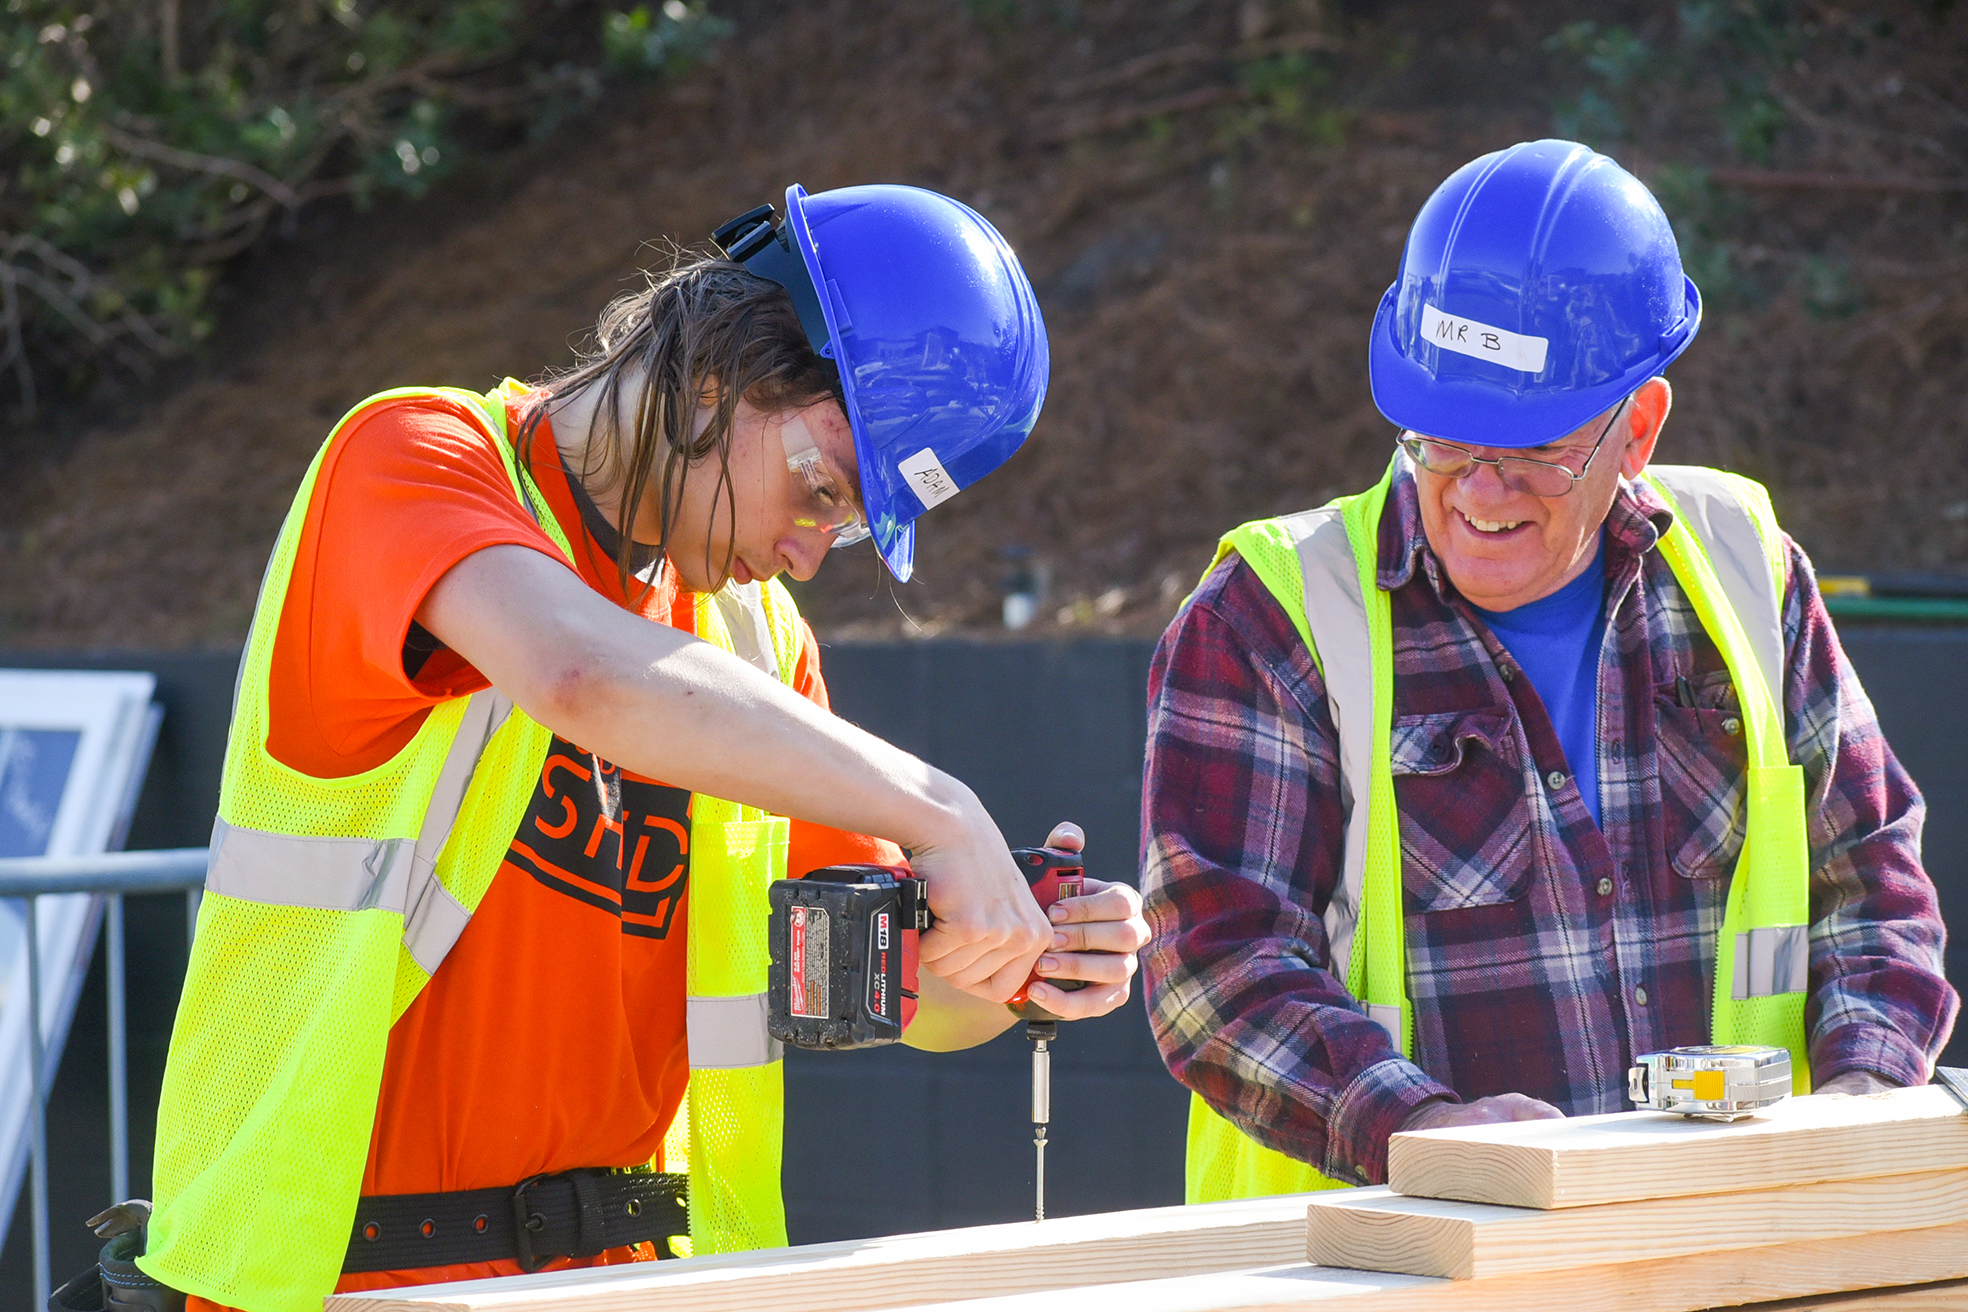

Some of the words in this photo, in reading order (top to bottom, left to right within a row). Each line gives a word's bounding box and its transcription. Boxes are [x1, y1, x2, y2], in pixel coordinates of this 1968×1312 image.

[1436, 320, 1468, 343] MR
[1481, 333, 1501, 350] B
[914, 468, 950, 498] ADAM
